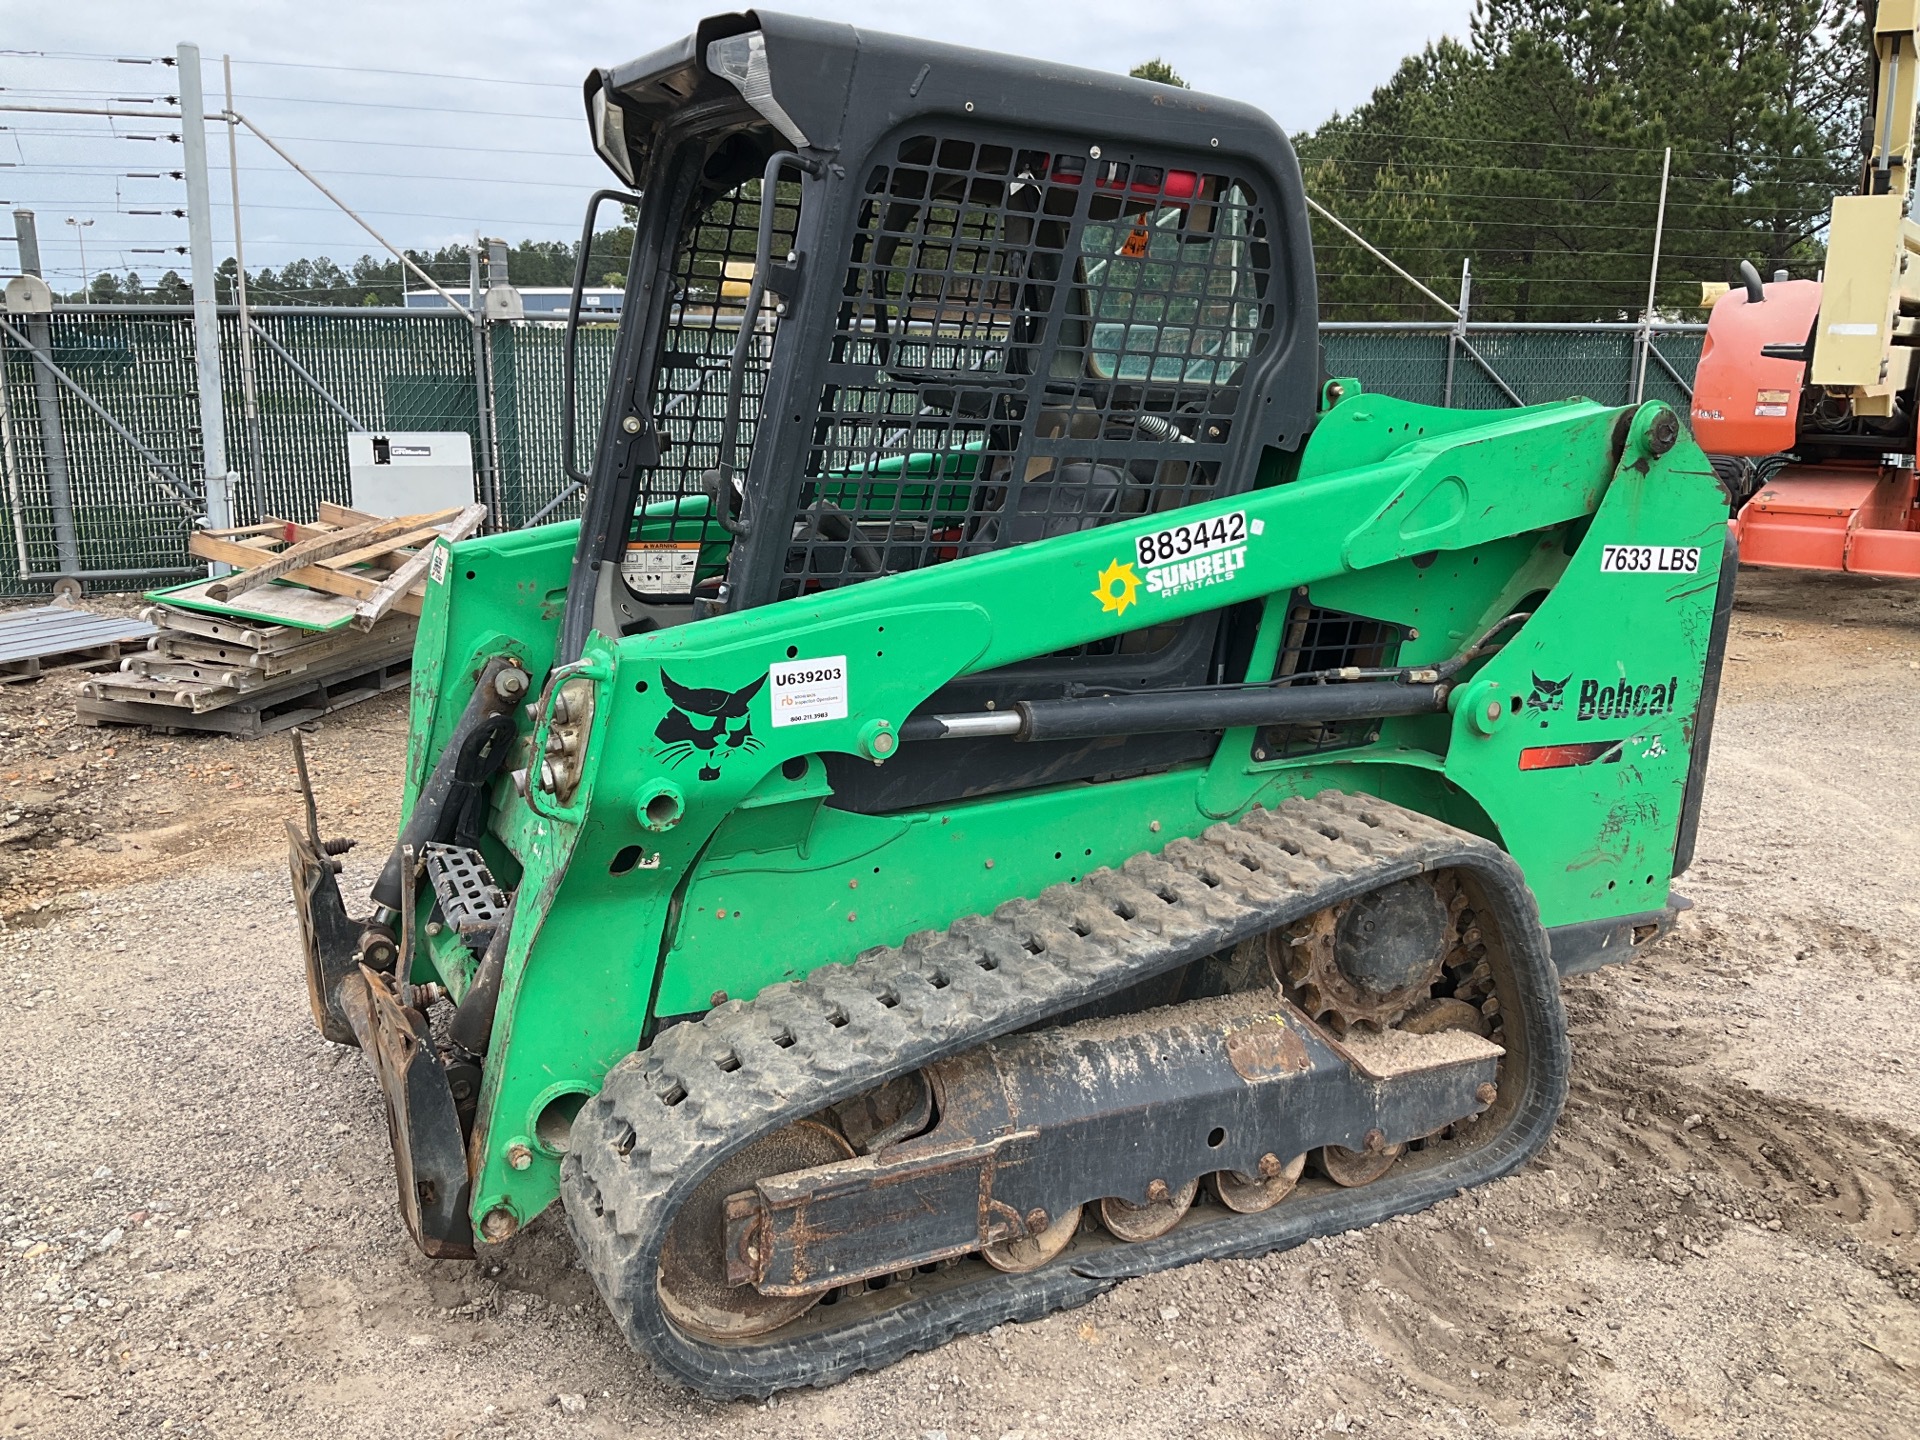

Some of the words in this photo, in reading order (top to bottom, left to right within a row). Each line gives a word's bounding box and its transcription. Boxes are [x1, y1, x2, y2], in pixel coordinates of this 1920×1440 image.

[1139, 513, 1245, 565] 883442
[1145, 545, 1248, 593] SUNBELT
[1604, 547, 1652, 571] 7633
[1658, 548, 1698, 572] LBS
[1161, 570, 1235, 599] RENTALS
[776, 668, 841, 687] U639203
[816, 695, 838, 703] Operations
[1577, 676, 1678, 721] Bobcat
